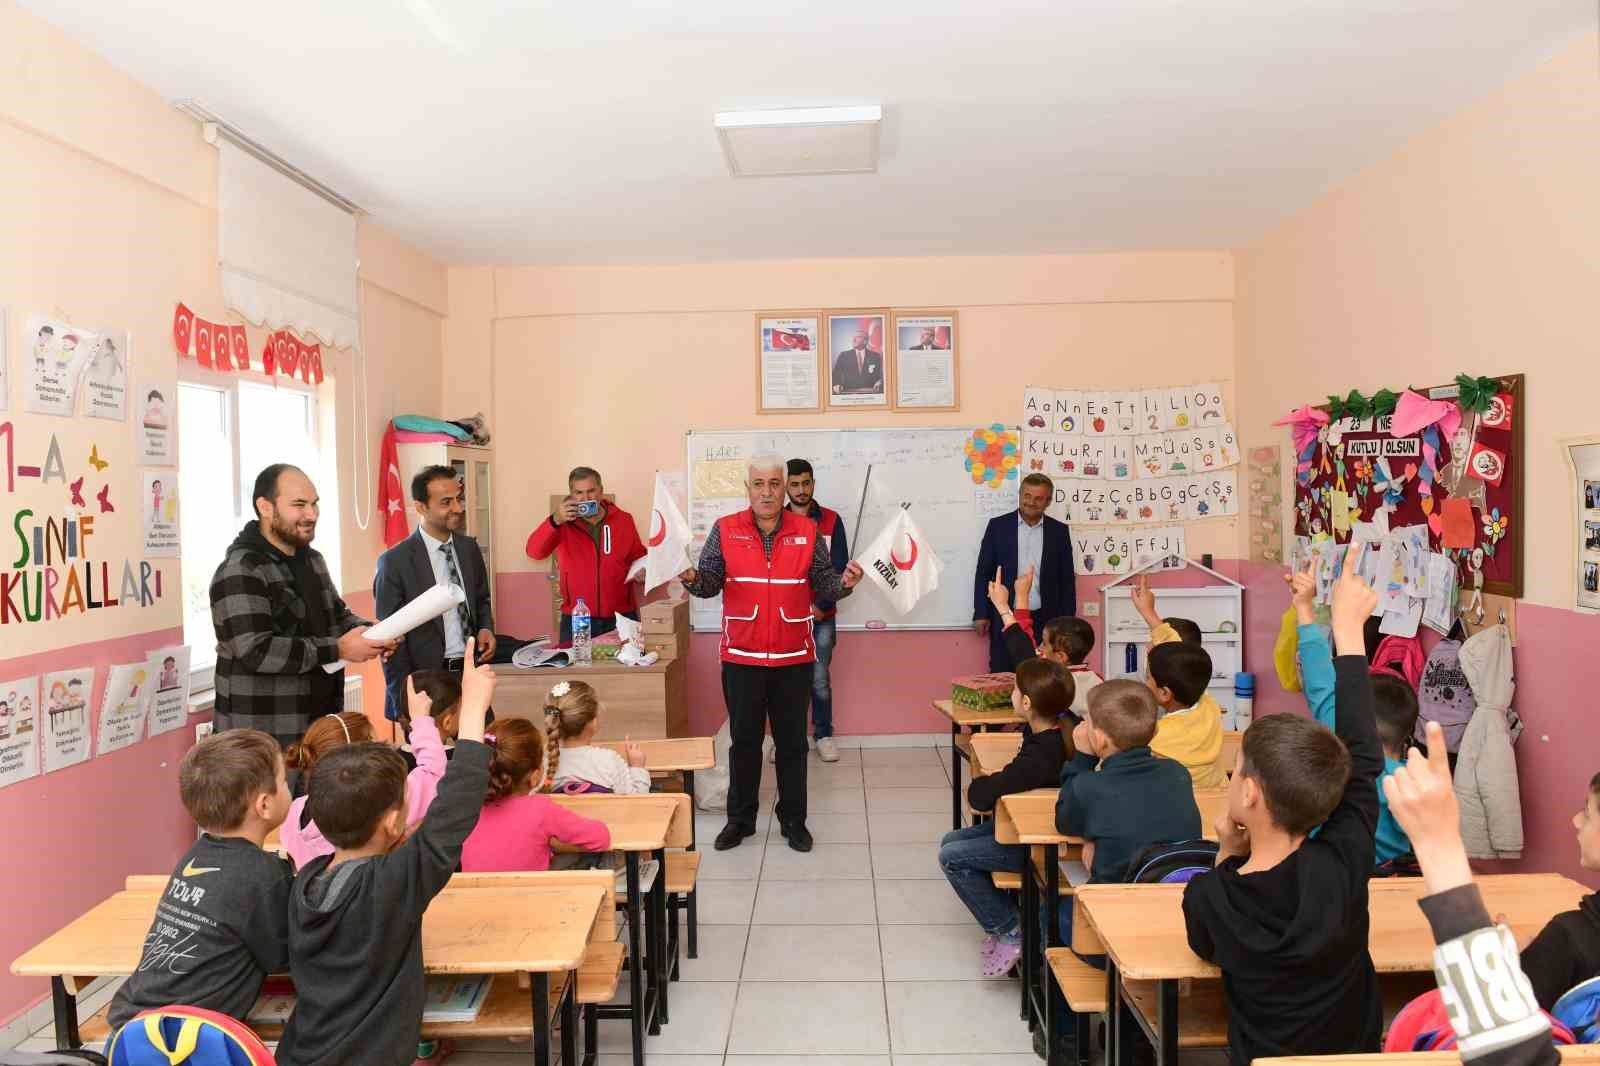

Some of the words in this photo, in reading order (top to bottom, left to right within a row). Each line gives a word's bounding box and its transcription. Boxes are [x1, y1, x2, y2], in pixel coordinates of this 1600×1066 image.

[1027, 396, 1037, 410] A
[1056, 399, 1067, 413] N
[1170, 396, 1179, 410] L
[1194, 393, 1206, 406] O
[1087, 401, 1096, 415] E
[1112, 401, 1124, 415] T
[1350, 418, 1361, 431] 23
[1380, 418, 1393, 430] NİS
[1029, 440, 1038, 453] K
[1053, 442, 1064, 456] U
[1082, 443, 1090, 457] R
[1135, 443, 1148, 456] M
[1193, 437, 1203, 451] S
[1351, 442, 1377, 454] KUTLU
[1385, 441, 1415, 454] OLSUN
[1055, 489, 1066, 503] D
[1082, 489, 1093, 503] Z
[1135, 488, 1143, 501] B
[1160, 486, 1172, 500] G
[1188, 484, 1199, 498] C
[13, 508, 95, 569] SINIF
[1078, 539, 1088, 552] V
[1135, 538, 1144, 553] F
[1161, 537, 1169, 550] J
[873, 559, 899, 590] KIZILAY
[1, 558, 162, 624] KURALLARI
